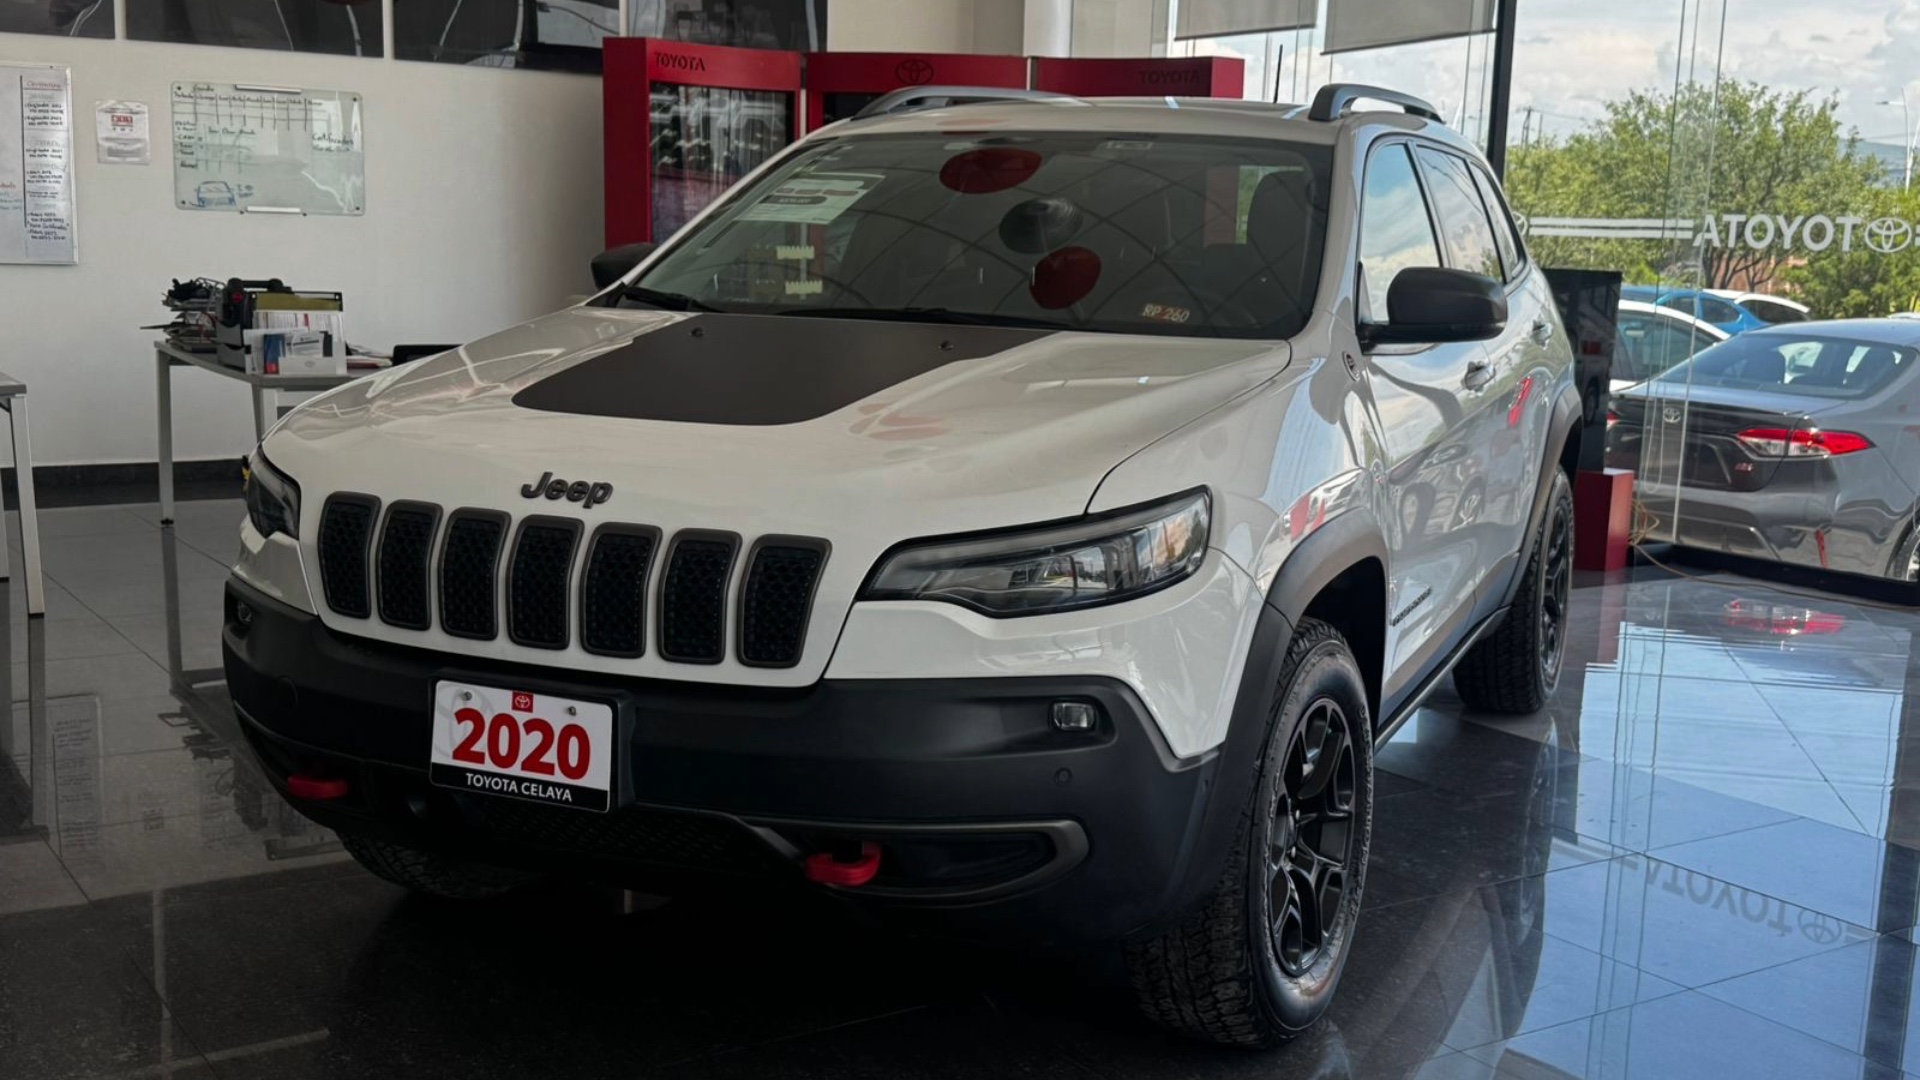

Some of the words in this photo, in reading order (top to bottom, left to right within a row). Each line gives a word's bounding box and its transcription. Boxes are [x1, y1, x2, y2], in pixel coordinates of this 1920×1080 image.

[655, 51, 705, 72] TOYOTA
[1139, 69, 1199, 84] TOYOTA
[521, 471, 614, 509] Jeep
[452, 707, 591, 780] 2020
[466, 772, 519, 793] TOYOTA
[521, 782, 572, 802] CELAYA
